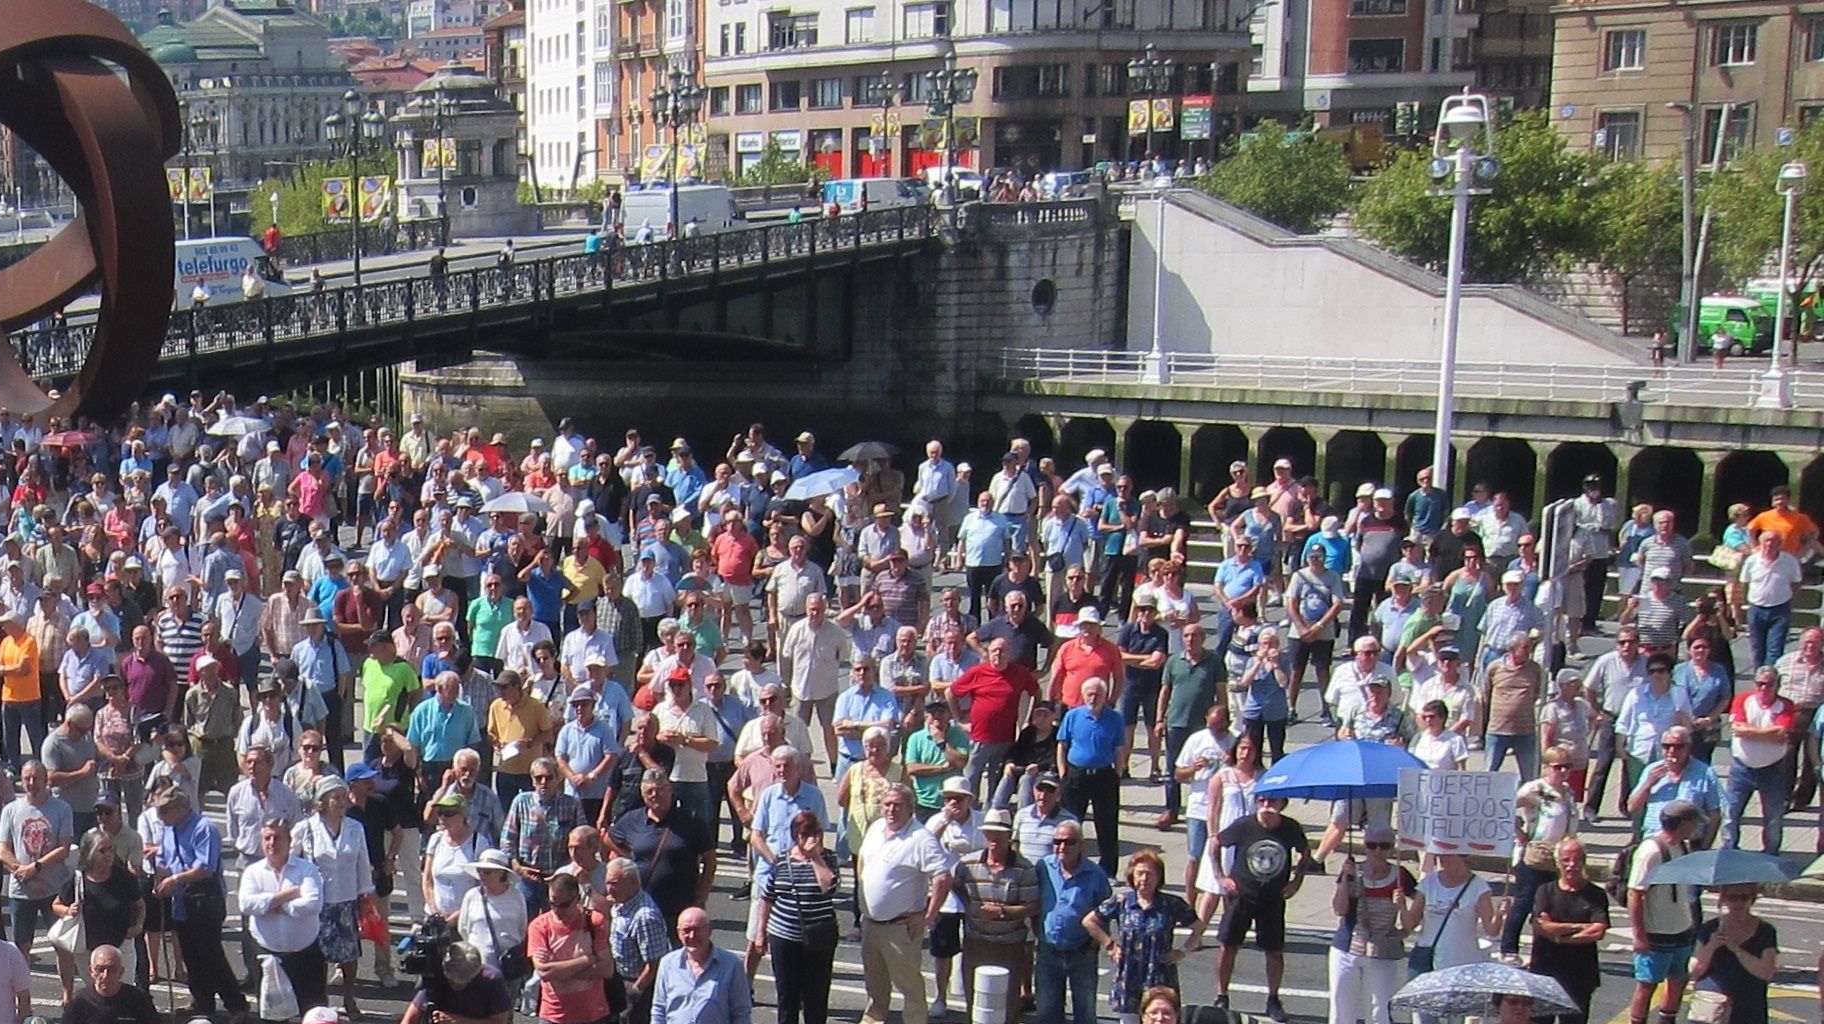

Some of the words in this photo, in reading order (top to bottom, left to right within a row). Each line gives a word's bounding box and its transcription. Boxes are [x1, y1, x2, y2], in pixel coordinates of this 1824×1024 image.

[178, 256, 248, 275] telefurgo
[1418, 773, 1491, 795] FUERA
[1401, 793, 1512, 819] SUELDOS
[1401, 815, 1512, 841] VITALICIOS
